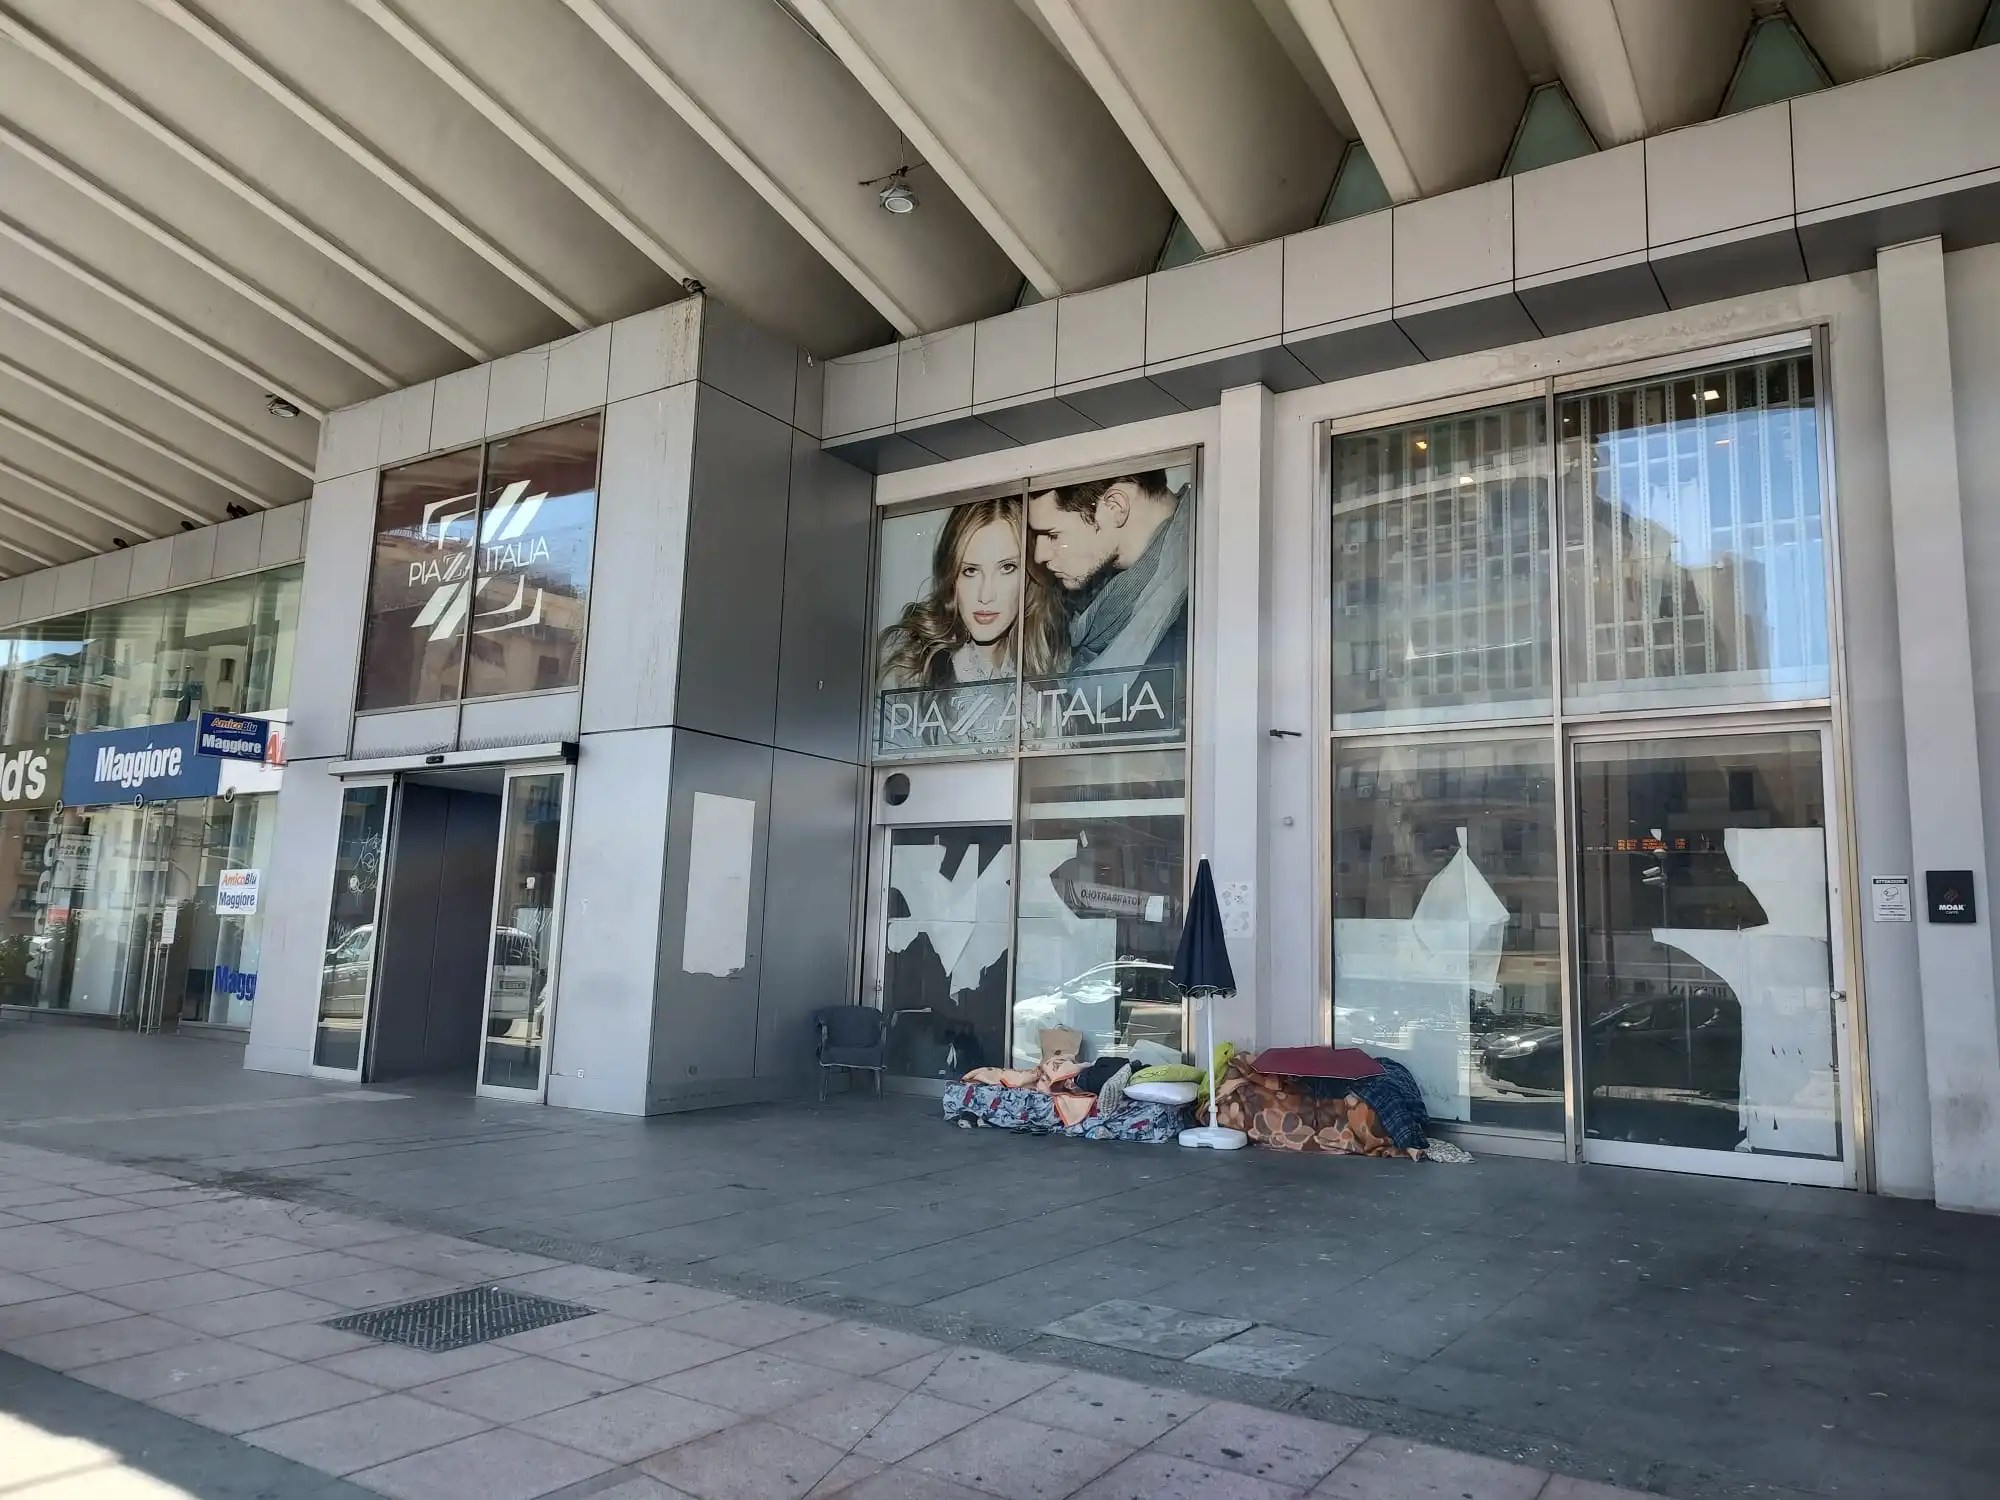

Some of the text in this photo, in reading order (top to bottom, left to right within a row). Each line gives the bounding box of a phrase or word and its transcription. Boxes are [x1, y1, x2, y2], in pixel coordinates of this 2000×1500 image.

[486, 536, 550, 572] ITALIA
[890, 681, 1165, 739] PIAZZA ITALIA
[211, 717, 257, 732] AmicoBlu
[202, 733, 262, 754] Maggiore
[95, 741, 182, 788] Maggiore
[222, 873, 257, 886] AmicoBlu
[219, 891, 255, 909] Maggiore
[215, 966, 257, 1001] Magg
